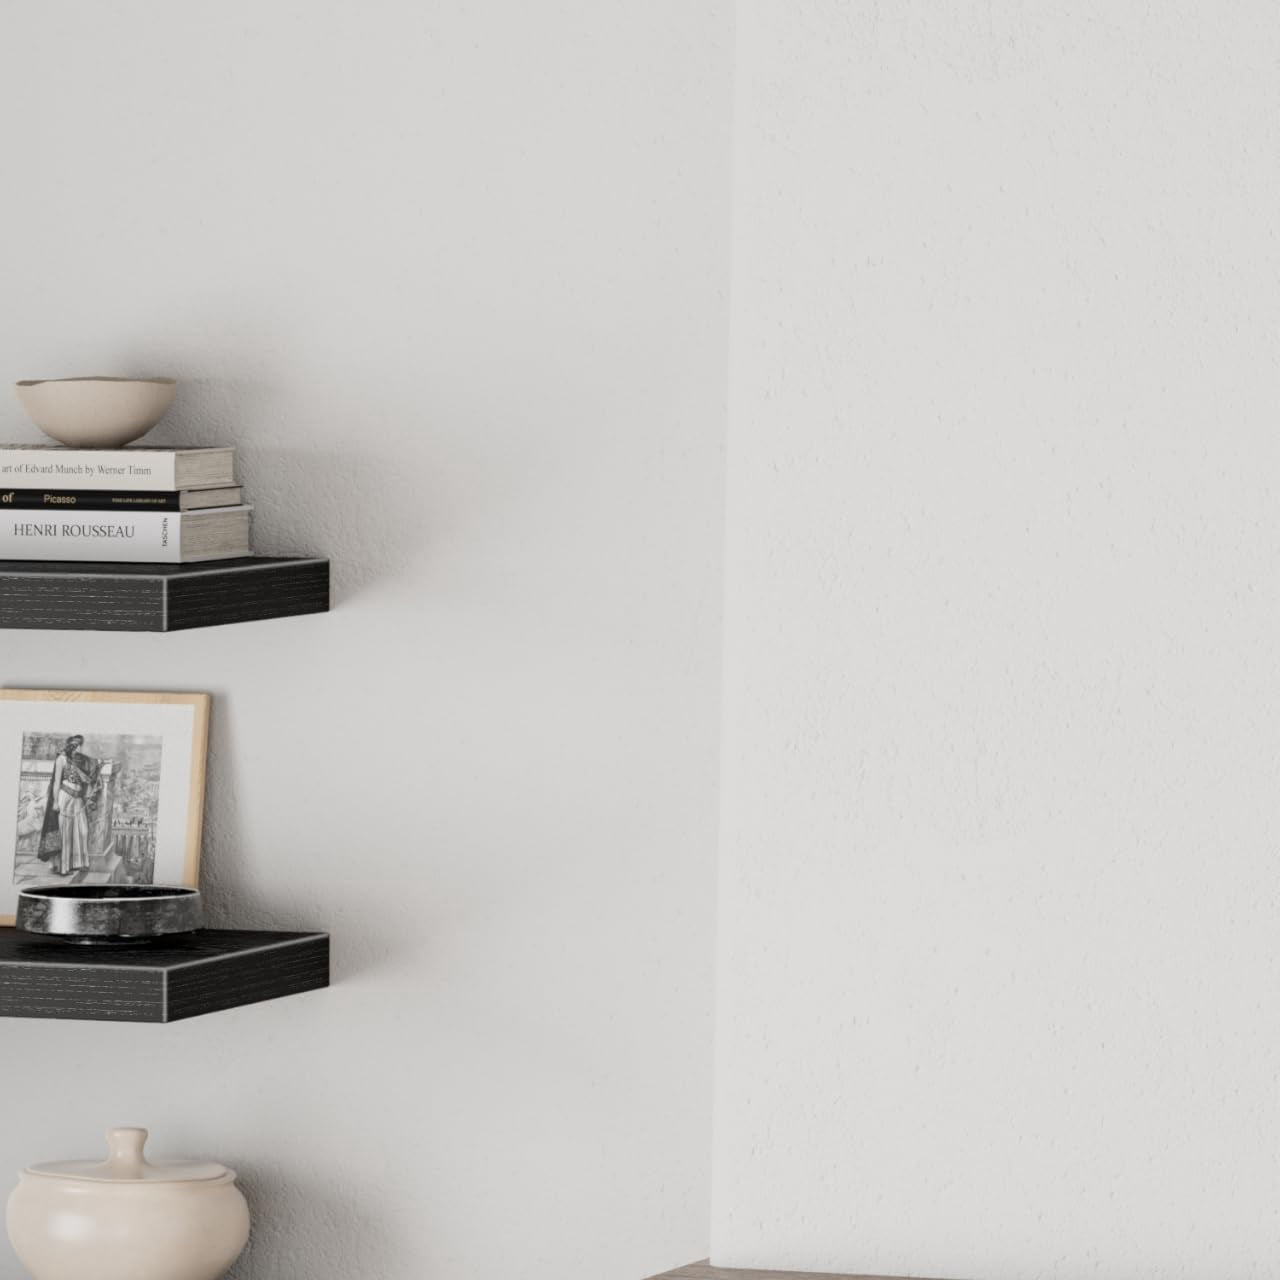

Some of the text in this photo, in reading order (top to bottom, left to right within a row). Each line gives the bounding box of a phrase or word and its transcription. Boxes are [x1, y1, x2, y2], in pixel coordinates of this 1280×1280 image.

[1, 464, 12, 473] art
[14, 463, 23, 473] of
[25, 463, 53, 474] Edvard
[55, 464, 82, 474] Munch
[85, 464, 94, 477] by
[97, 465, 125, 475] Werner
[2, 491, 15, 503] of
[43, 493, 77, 504] Picasso
[14, 523, 135, 538] HENRI ROUSSEAU
